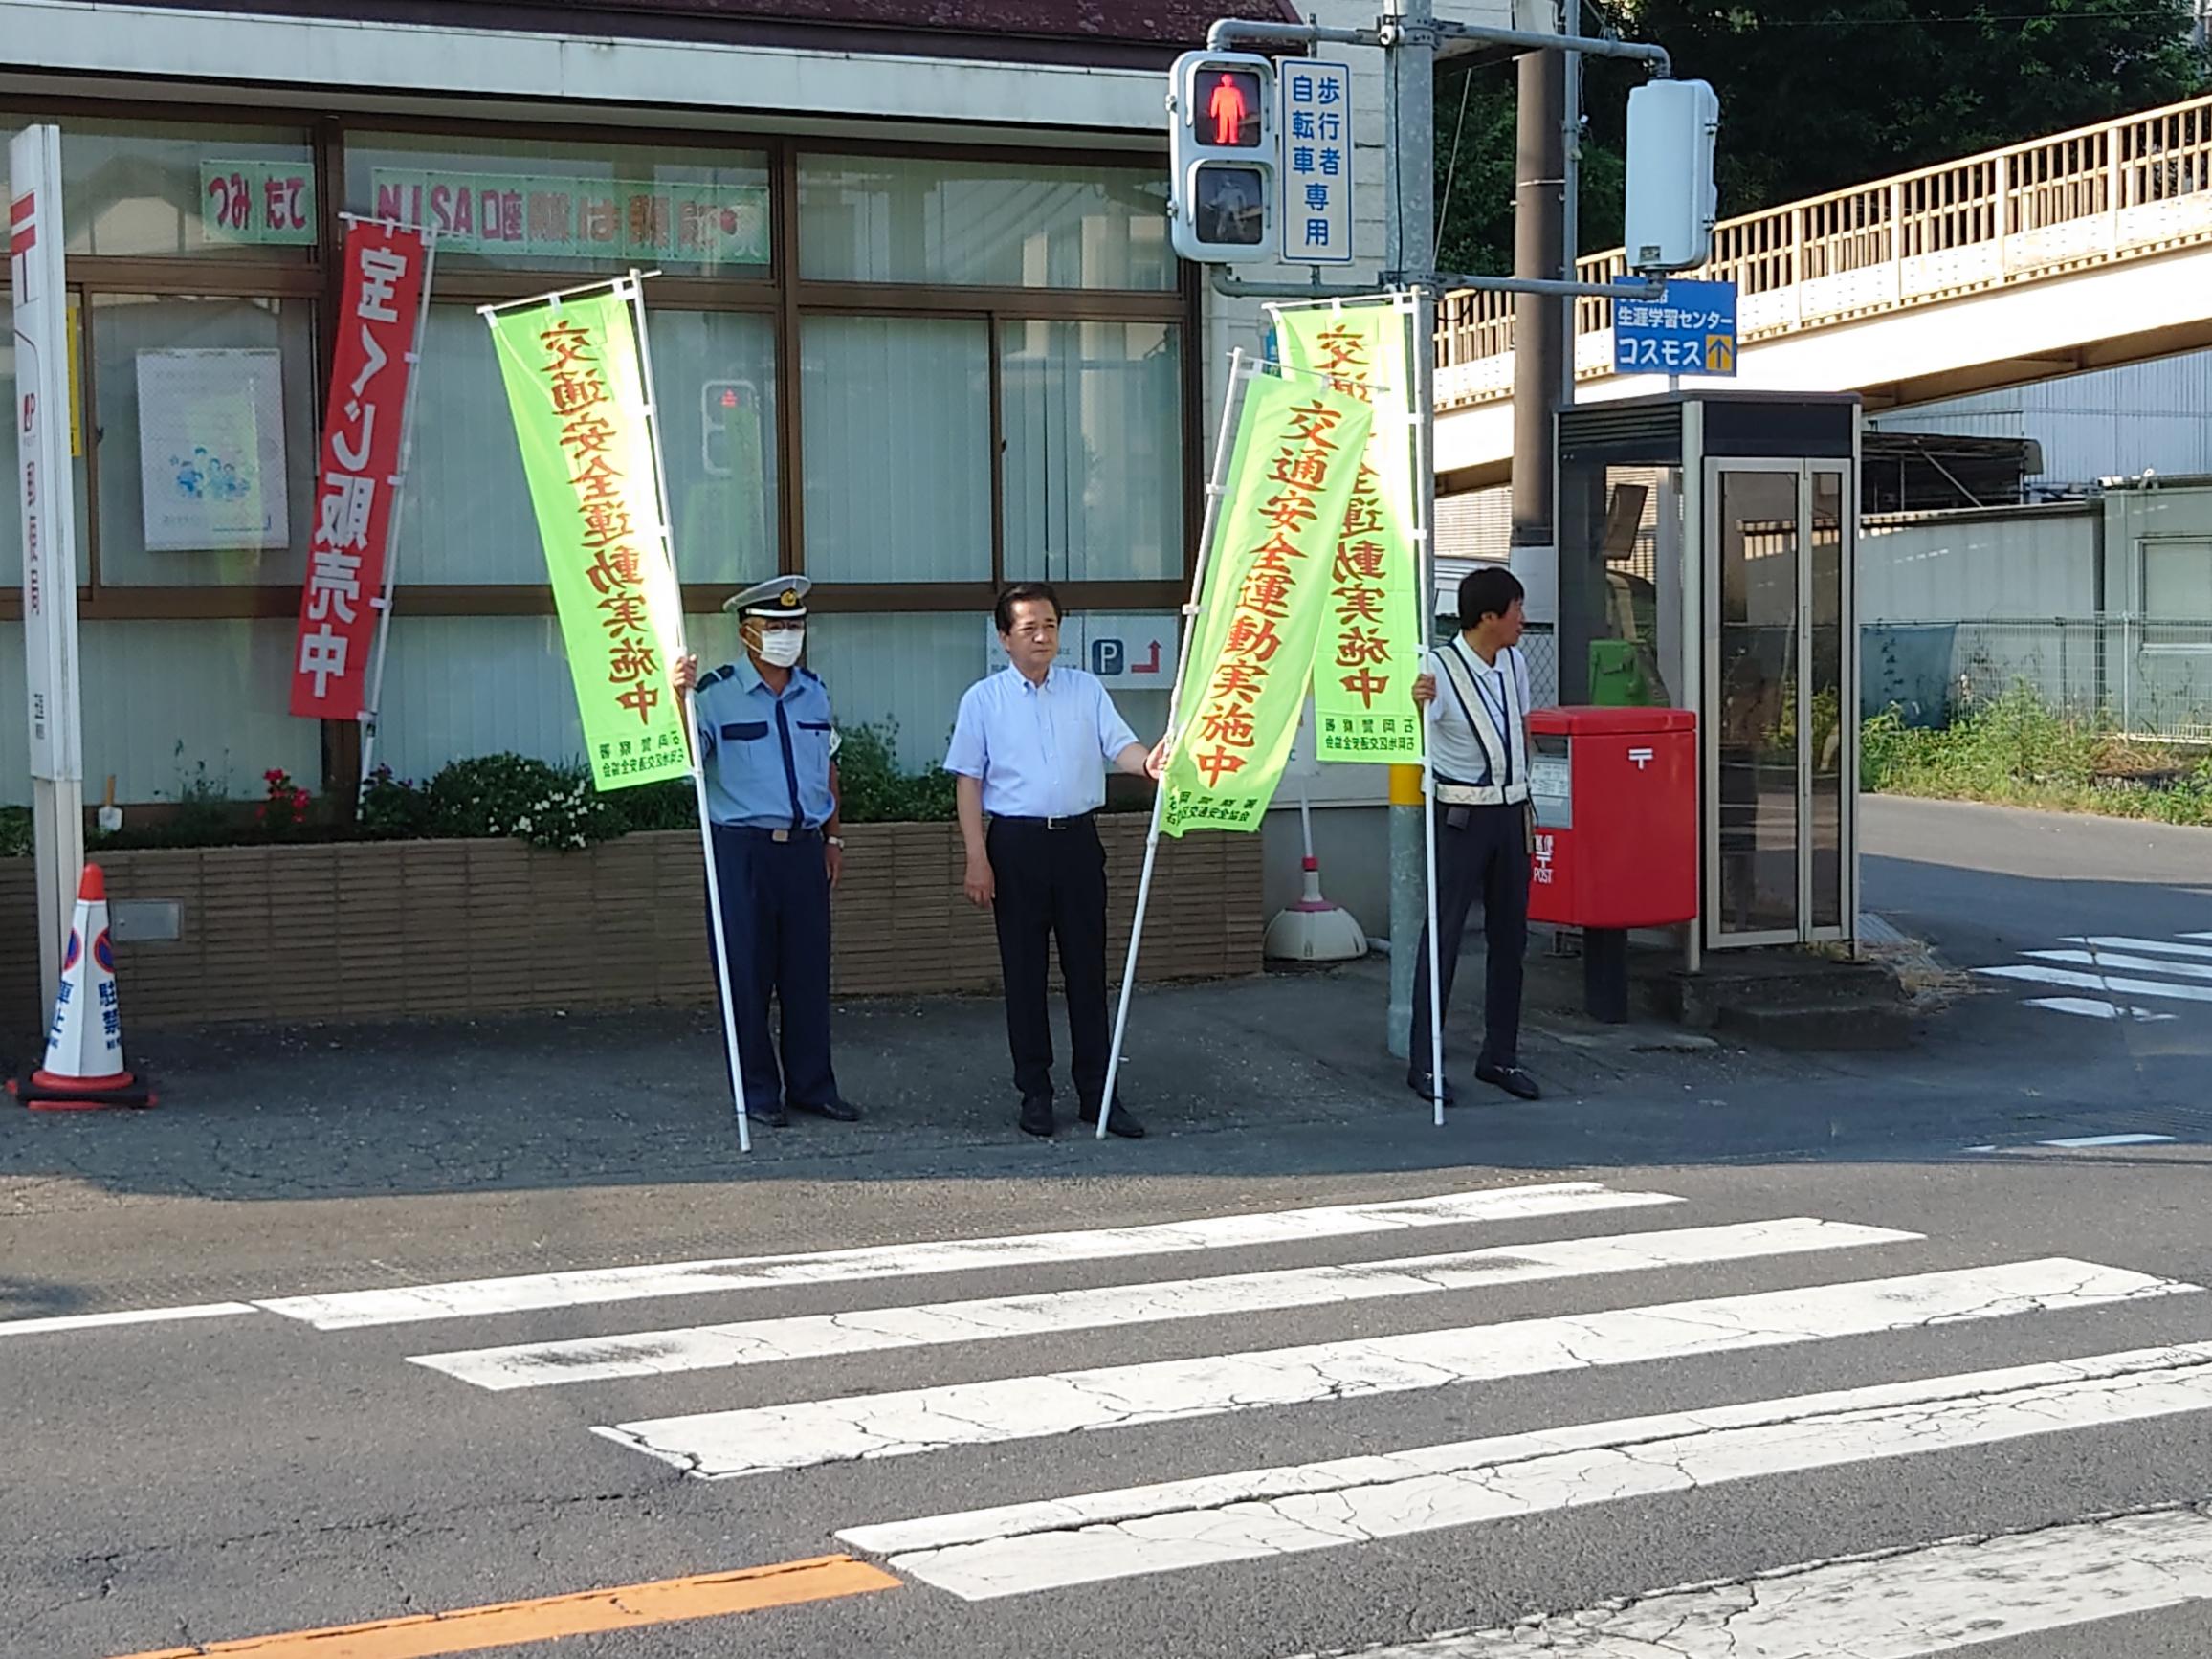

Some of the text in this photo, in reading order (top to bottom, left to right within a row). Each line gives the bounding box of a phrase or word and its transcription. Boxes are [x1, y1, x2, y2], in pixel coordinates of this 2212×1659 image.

[1292, 75, 1316, 175] 自転車
[1317, 77, 1341, 176] 歩行者
[1304, 182, 1329, 246] 専用
[1617, 306, 1733, 329] 生涯学習センター
[1618, 337, 1701, 366] コスモス
[1197, 399, 1342, 788] 交通安全運動実施中
[1100, 642, 1118, 674] P
[1533, 867, 1555, 884] POST
